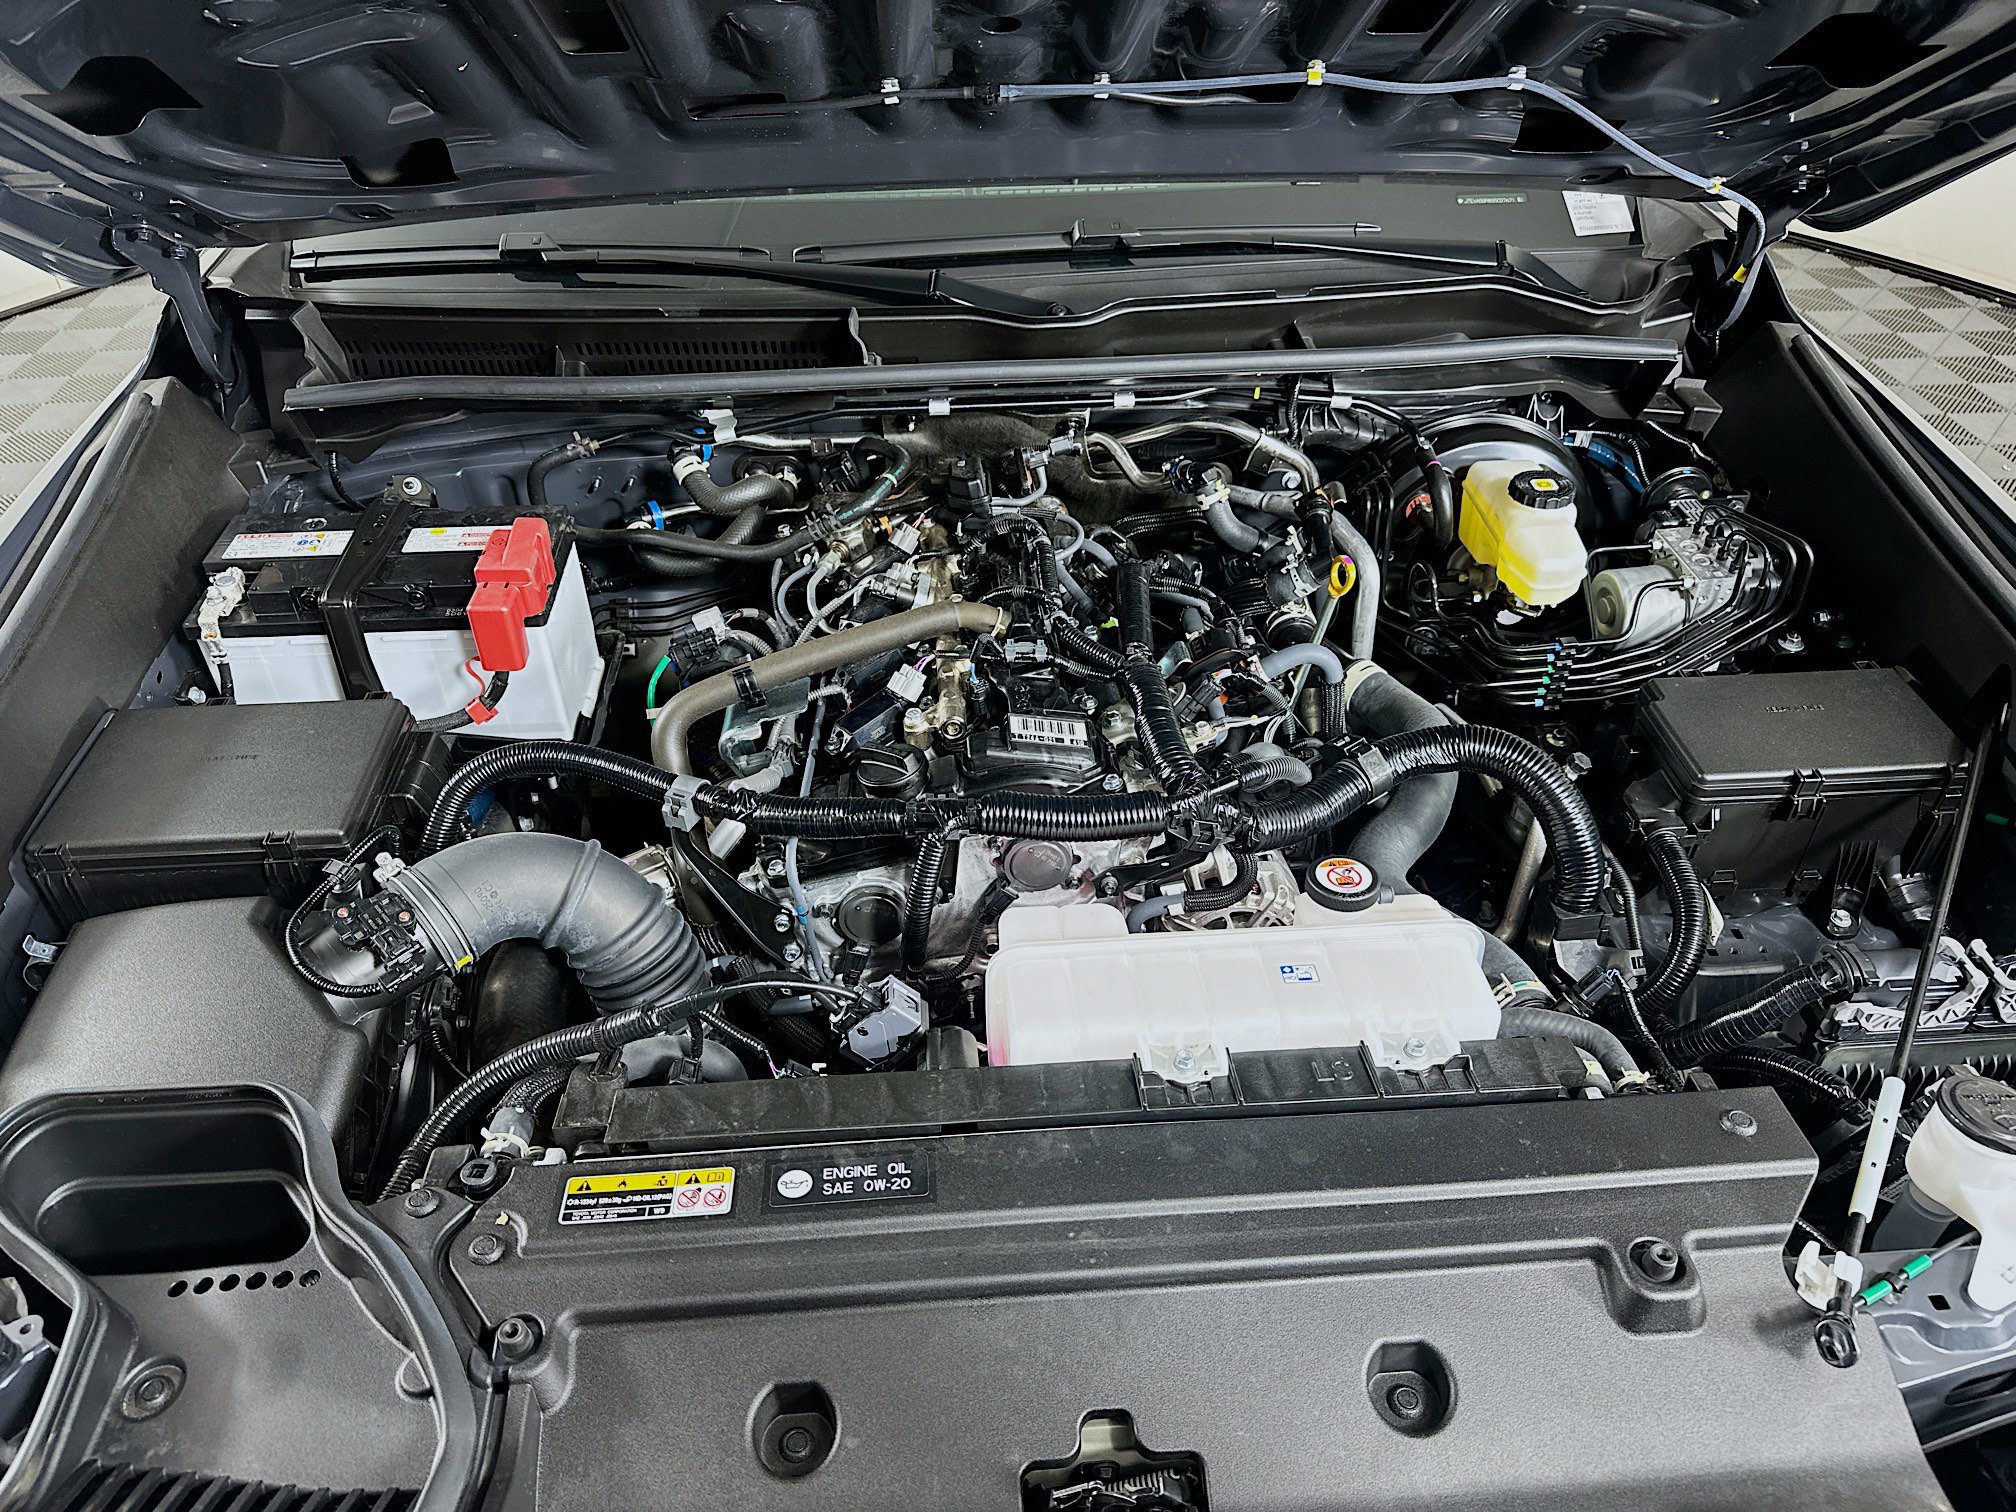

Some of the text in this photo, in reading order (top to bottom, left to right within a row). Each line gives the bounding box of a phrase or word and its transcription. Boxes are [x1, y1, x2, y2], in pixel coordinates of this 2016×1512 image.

[823, 1162, 911, 1180] ENGINE OIL
[822, 1177, 911, 1196] SAE 0W-20
